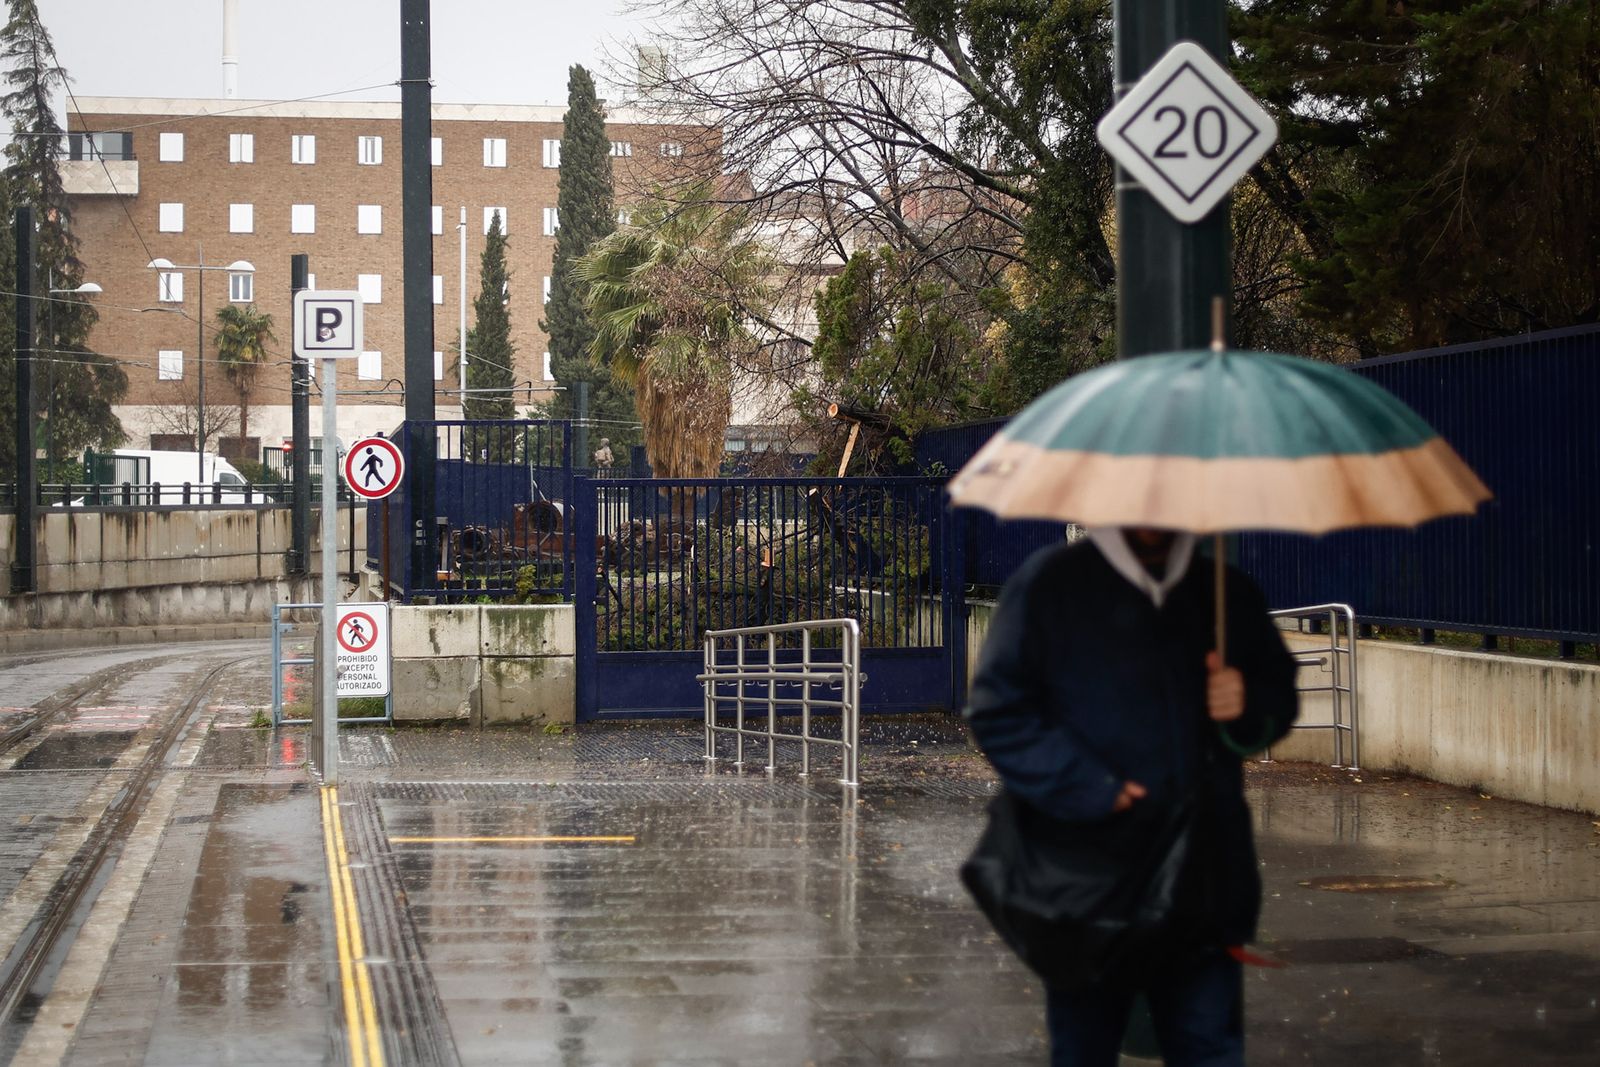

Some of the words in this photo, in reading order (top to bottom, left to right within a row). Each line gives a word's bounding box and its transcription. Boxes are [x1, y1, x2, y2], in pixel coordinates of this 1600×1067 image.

[1153, 105, 1228, 159] 20
[316, 307, 343, 342] P
[337, 655, 378, 663] PROHIBIDO
[342, 664, 375, 672] XCEPTO
[336, 682, 382, 690] AUTORIZADO
